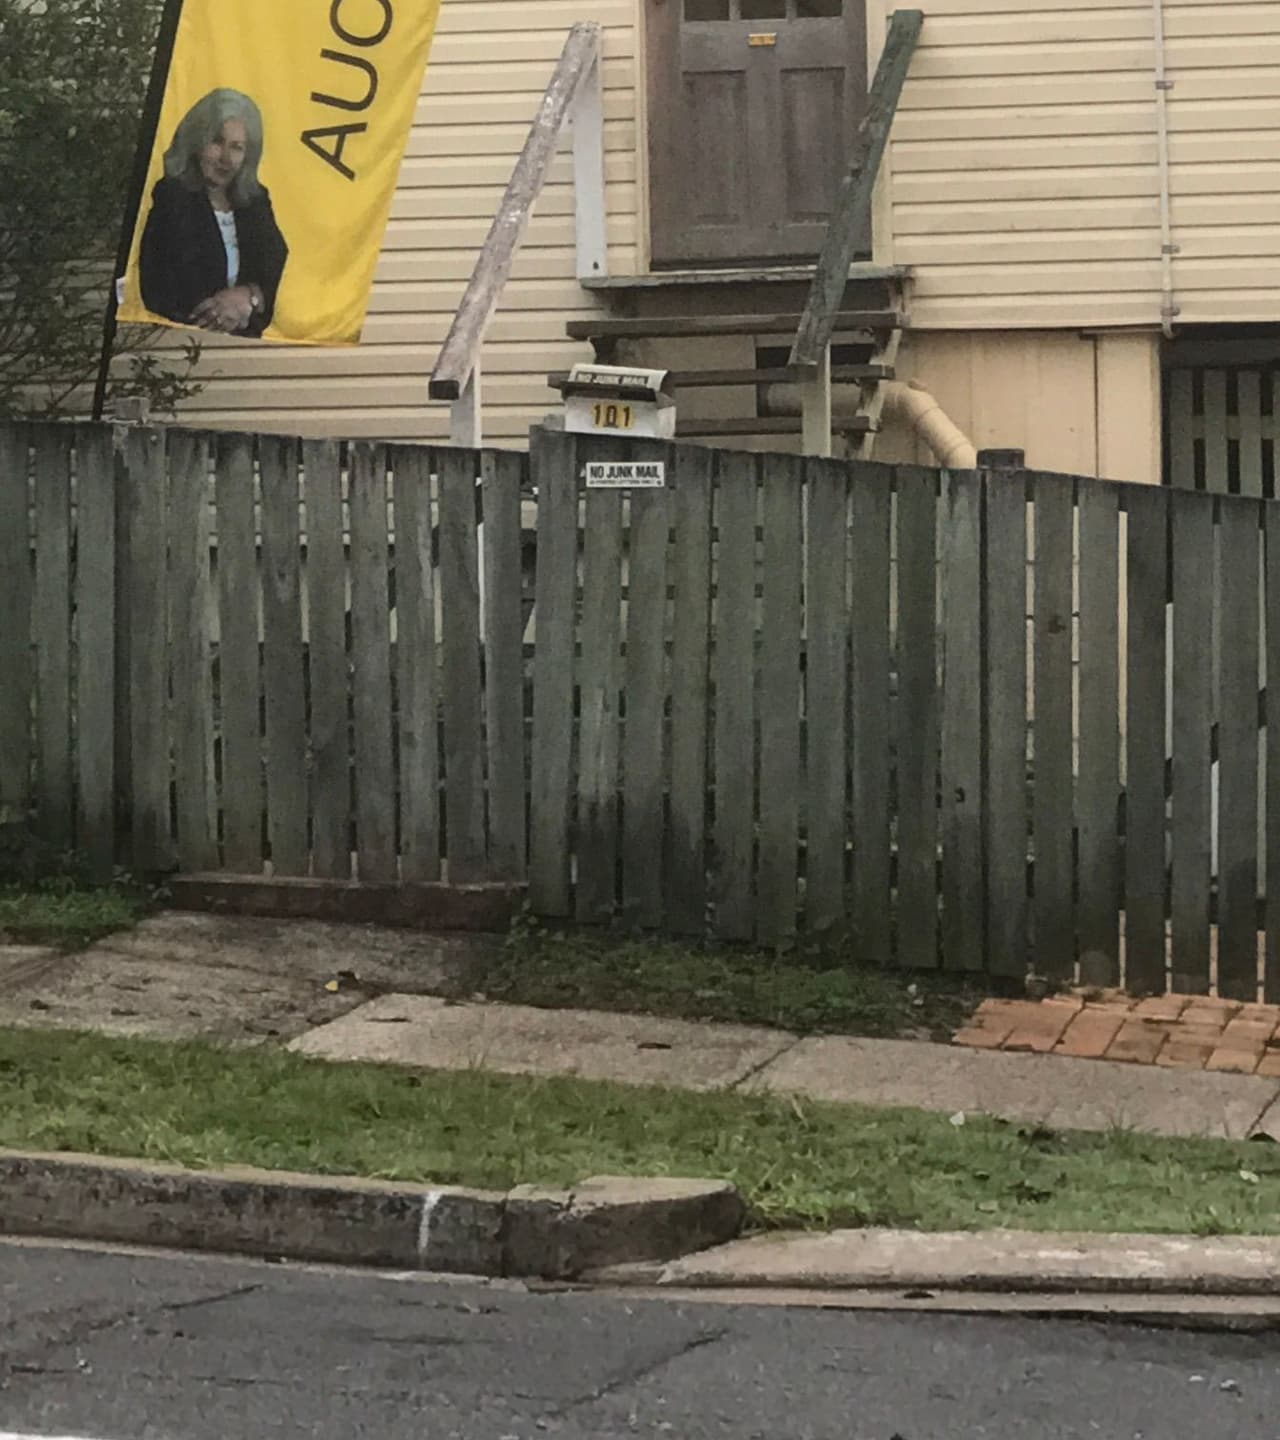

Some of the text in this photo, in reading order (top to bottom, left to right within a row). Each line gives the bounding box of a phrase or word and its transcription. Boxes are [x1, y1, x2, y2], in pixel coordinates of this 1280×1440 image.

[593, 404, 630, 428] 101
[590, 465, 660, 478] NO JUNK MAIL
